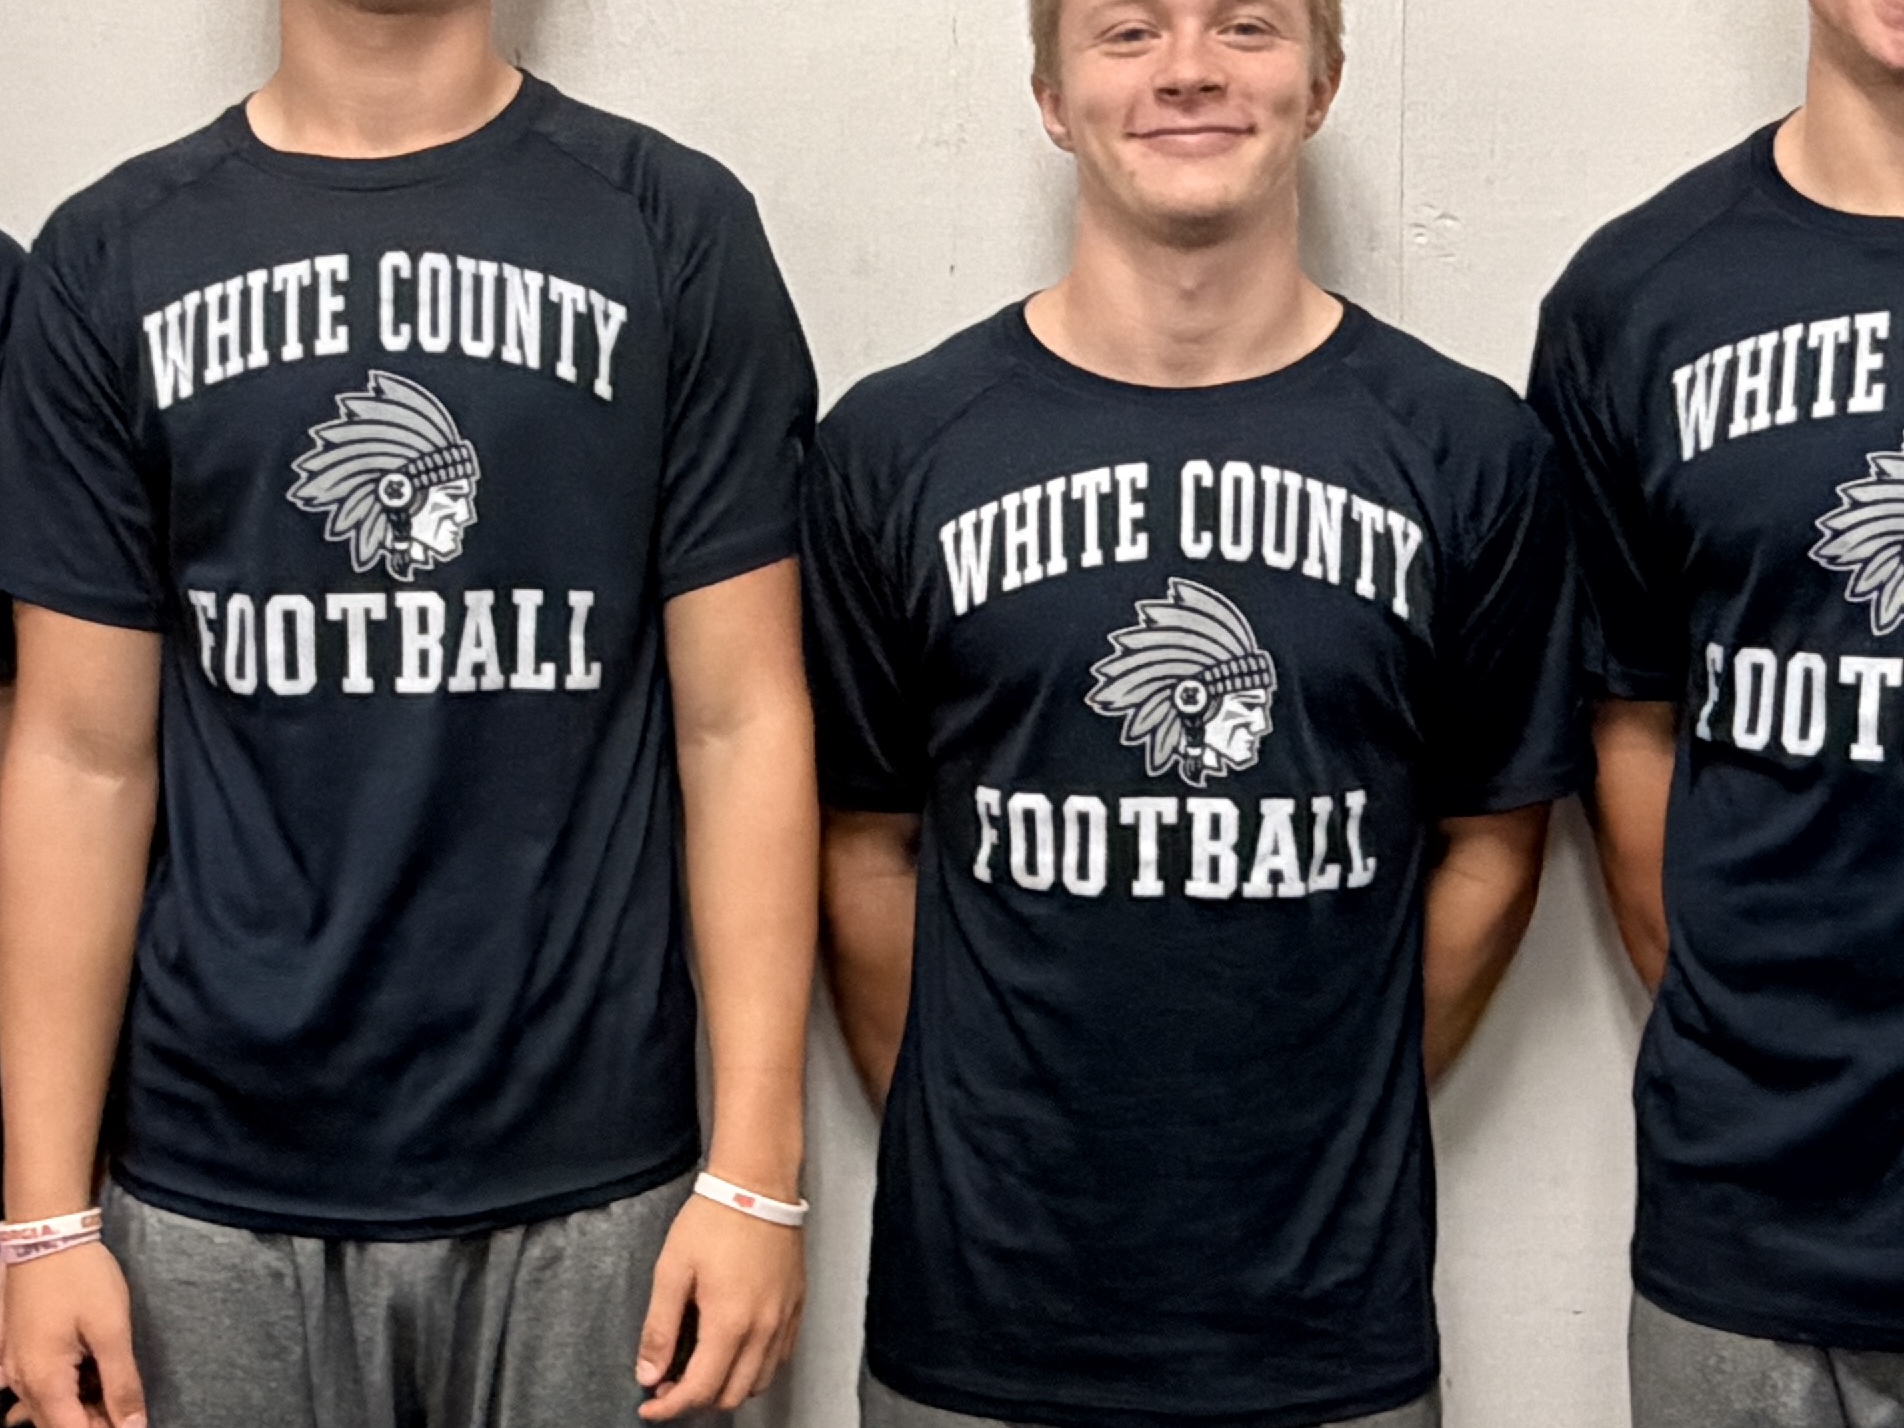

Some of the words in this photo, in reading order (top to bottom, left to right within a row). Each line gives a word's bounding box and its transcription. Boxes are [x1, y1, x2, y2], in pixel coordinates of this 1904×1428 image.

[143, 253, 349, 410] WHITE
[379, 251, 627, 402] COUNTY
[1673, 311, 1891, 461] WHITE
[939, 462, 1149, 615] WHITE
[1181, 459, 1423, 619] COUNTY
[972, 786, 1377, 899] FOOTBALL
